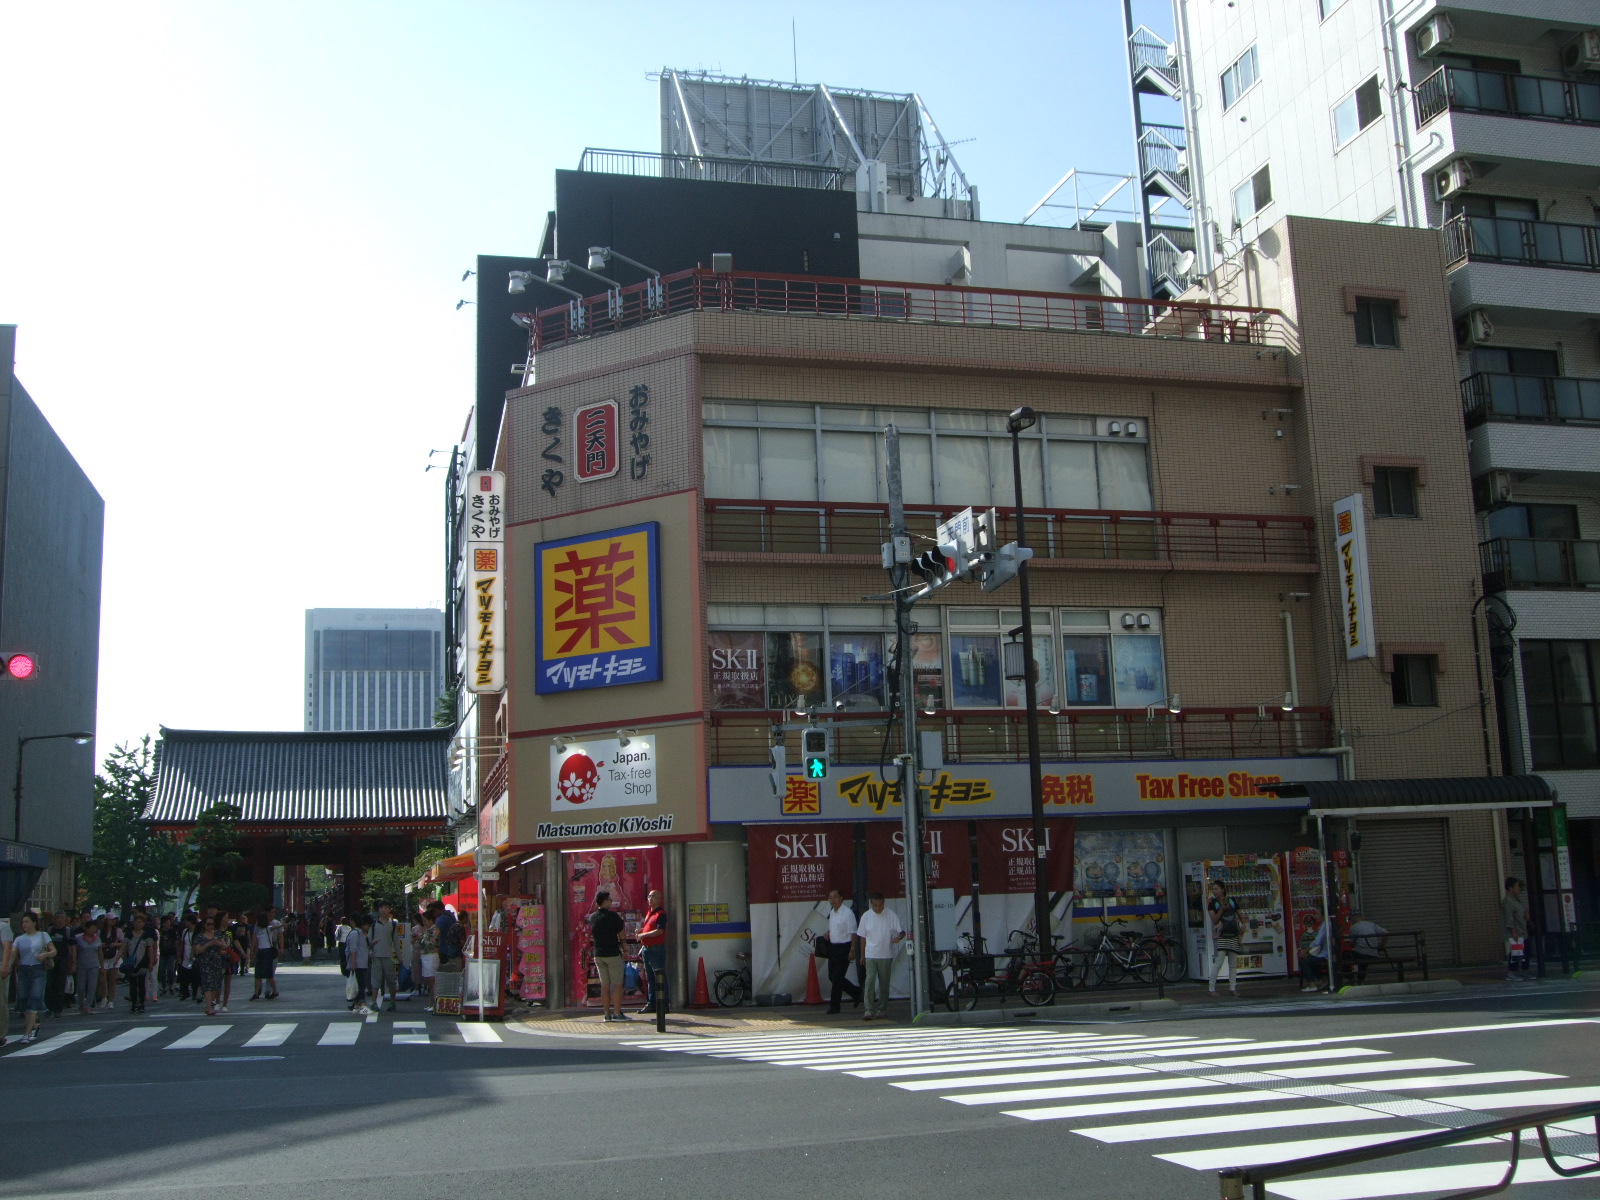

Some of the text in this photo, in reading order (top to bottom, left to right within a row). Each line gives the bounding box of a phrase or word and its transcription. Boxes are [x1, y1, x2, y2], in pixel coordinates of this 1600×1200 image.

[585, 408, 606, 473] 二天門
[629, 383, 650, 480] おみやげ
[541, 406, 563, 497] きくや
[471, 494, 485, 538] きくや
[489, 494, 500, 538] おみやげ
[475, 549, 497, 571] 薬
[554, 541, 636, 654] 薬
[1340, 538, 1359, 648] マツモトキヨシ
[475, 577, 496, 686] マツモトキヨシ
[546, 654, 647, 688] マツモトキヨシ
[608, 767, 651, 782] Tax-free
[612, 750, 650, 767] Japan.
[624, 782, 652, 797] Shop
[785, 777, 817, 813] 薬
[1040, 774, 1093, 804] 免税
[1137, 772, 1281, 800] Tax Free Shop
[537, 821, 617, 839] Matsumoto
[775, 833, 829, 859] SK-II
